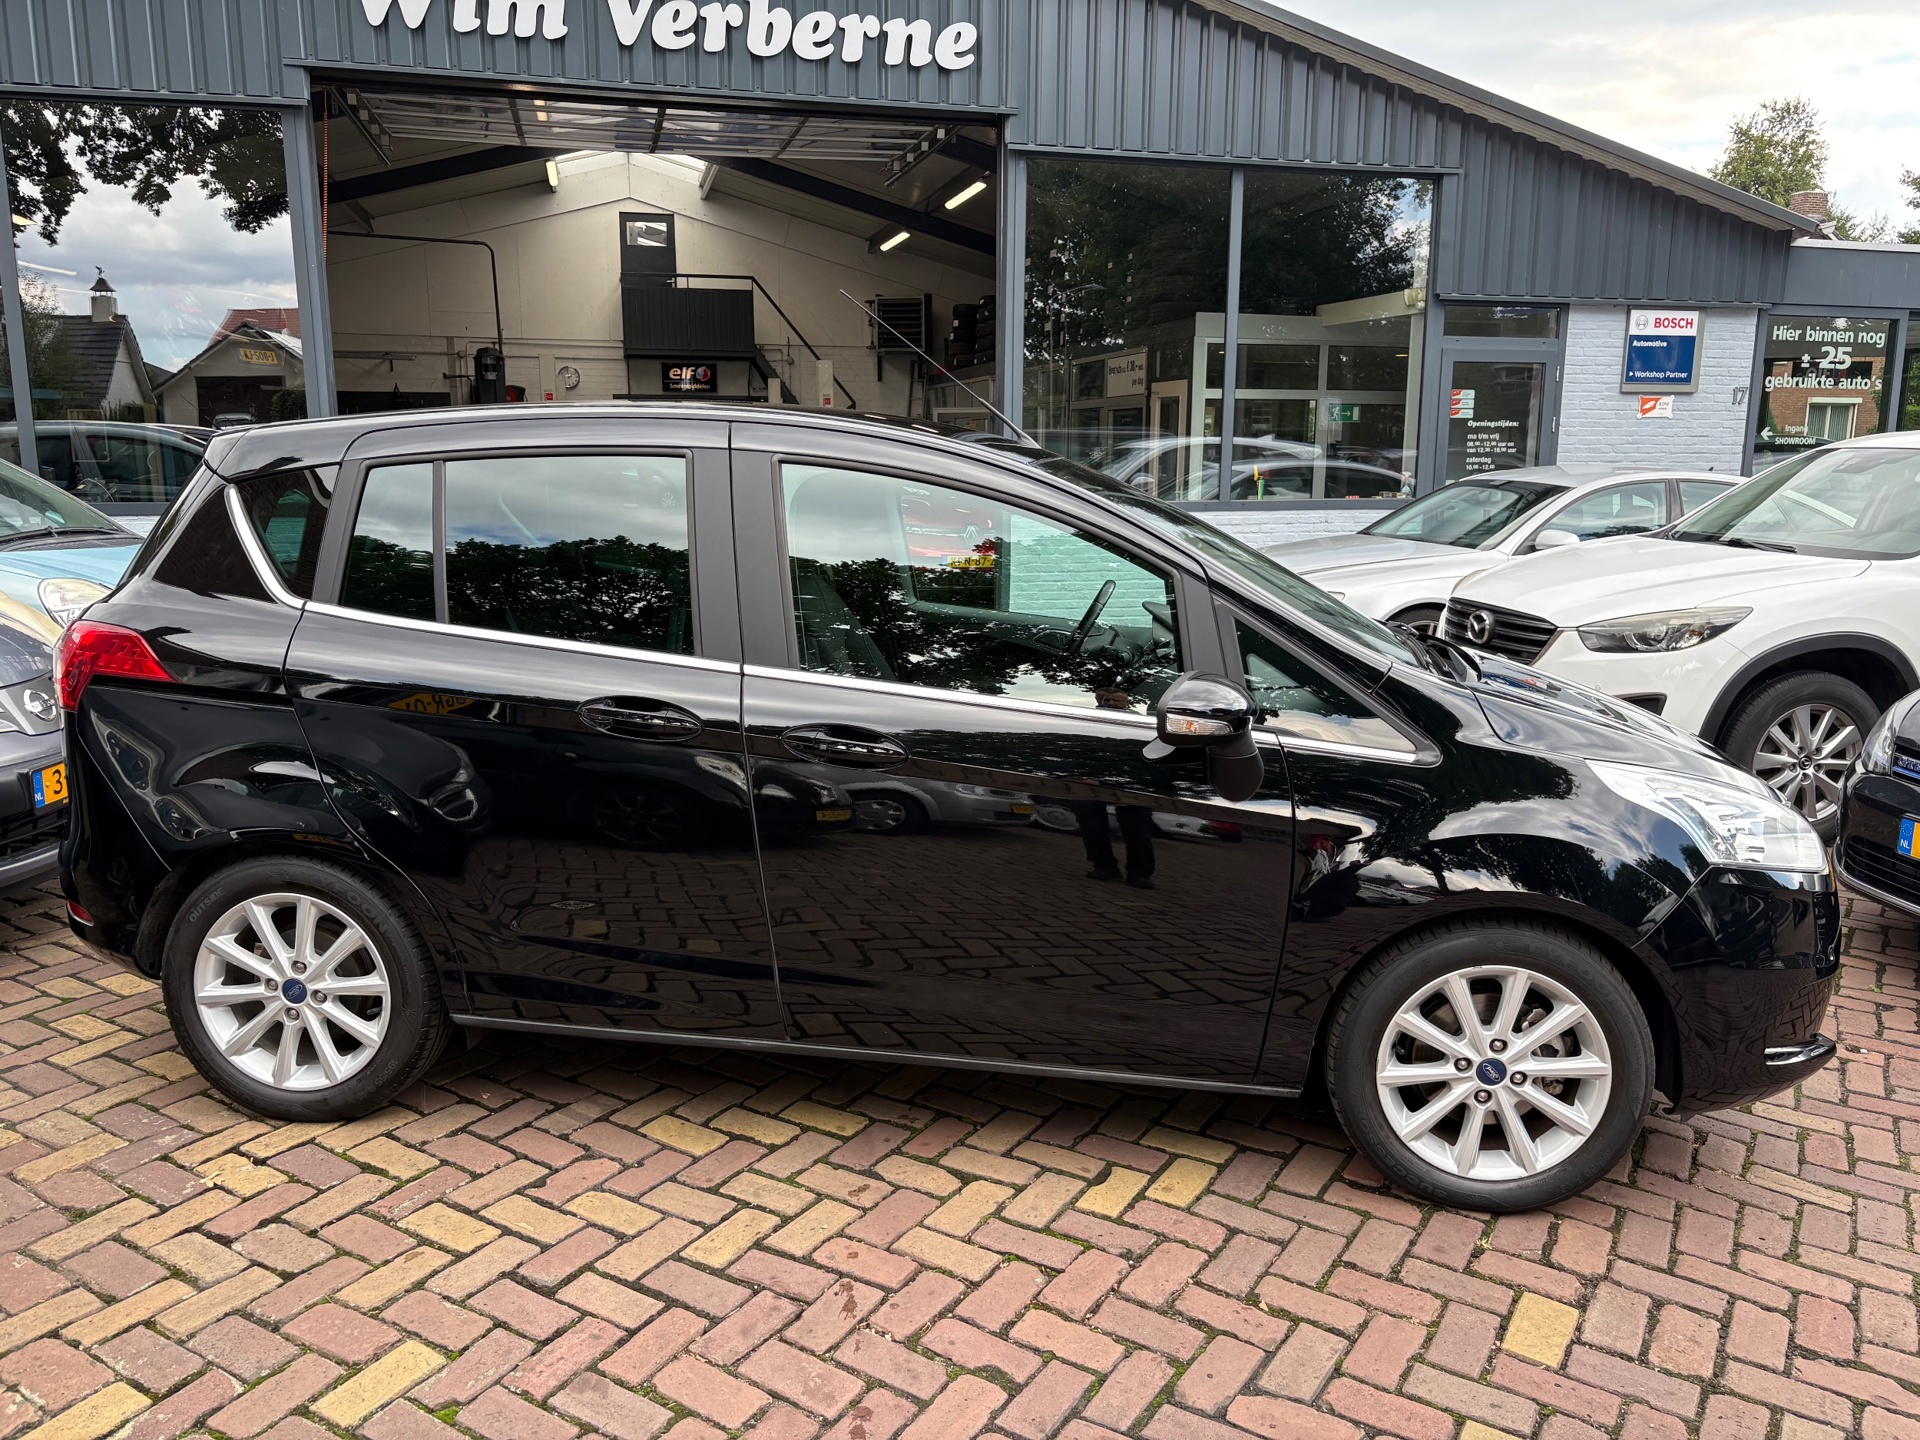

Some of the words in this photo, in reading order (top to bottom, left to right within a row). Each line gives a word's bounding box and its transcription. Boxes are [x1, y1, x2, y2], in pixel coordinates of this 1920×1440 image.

[607, 0, 977, 70] Verberne
[1654, 318, 1694, 329] BOSCH
[1772, 326, 1802, 340] Hier
[1806, 326, 1854, 343] binnen
[1858, 332, 1885, 348] nog
[1819, 346, 1852, 369] 25
[669, 367, 695, 379] elf
[1635, 371, 1665, 379] Workshop
[1765, 373, 1834, 392] gebruikte
[1838, 376, 1882, 390] auto's
[1732, 387, 1748, 404] 17
[1468, 420, 1519, 428] Openingstijden:
[35, 792, 43, 801] NL
[1900, 839, 1910, 849] NL
[188, 886, 226, 923] OUTSIDE
